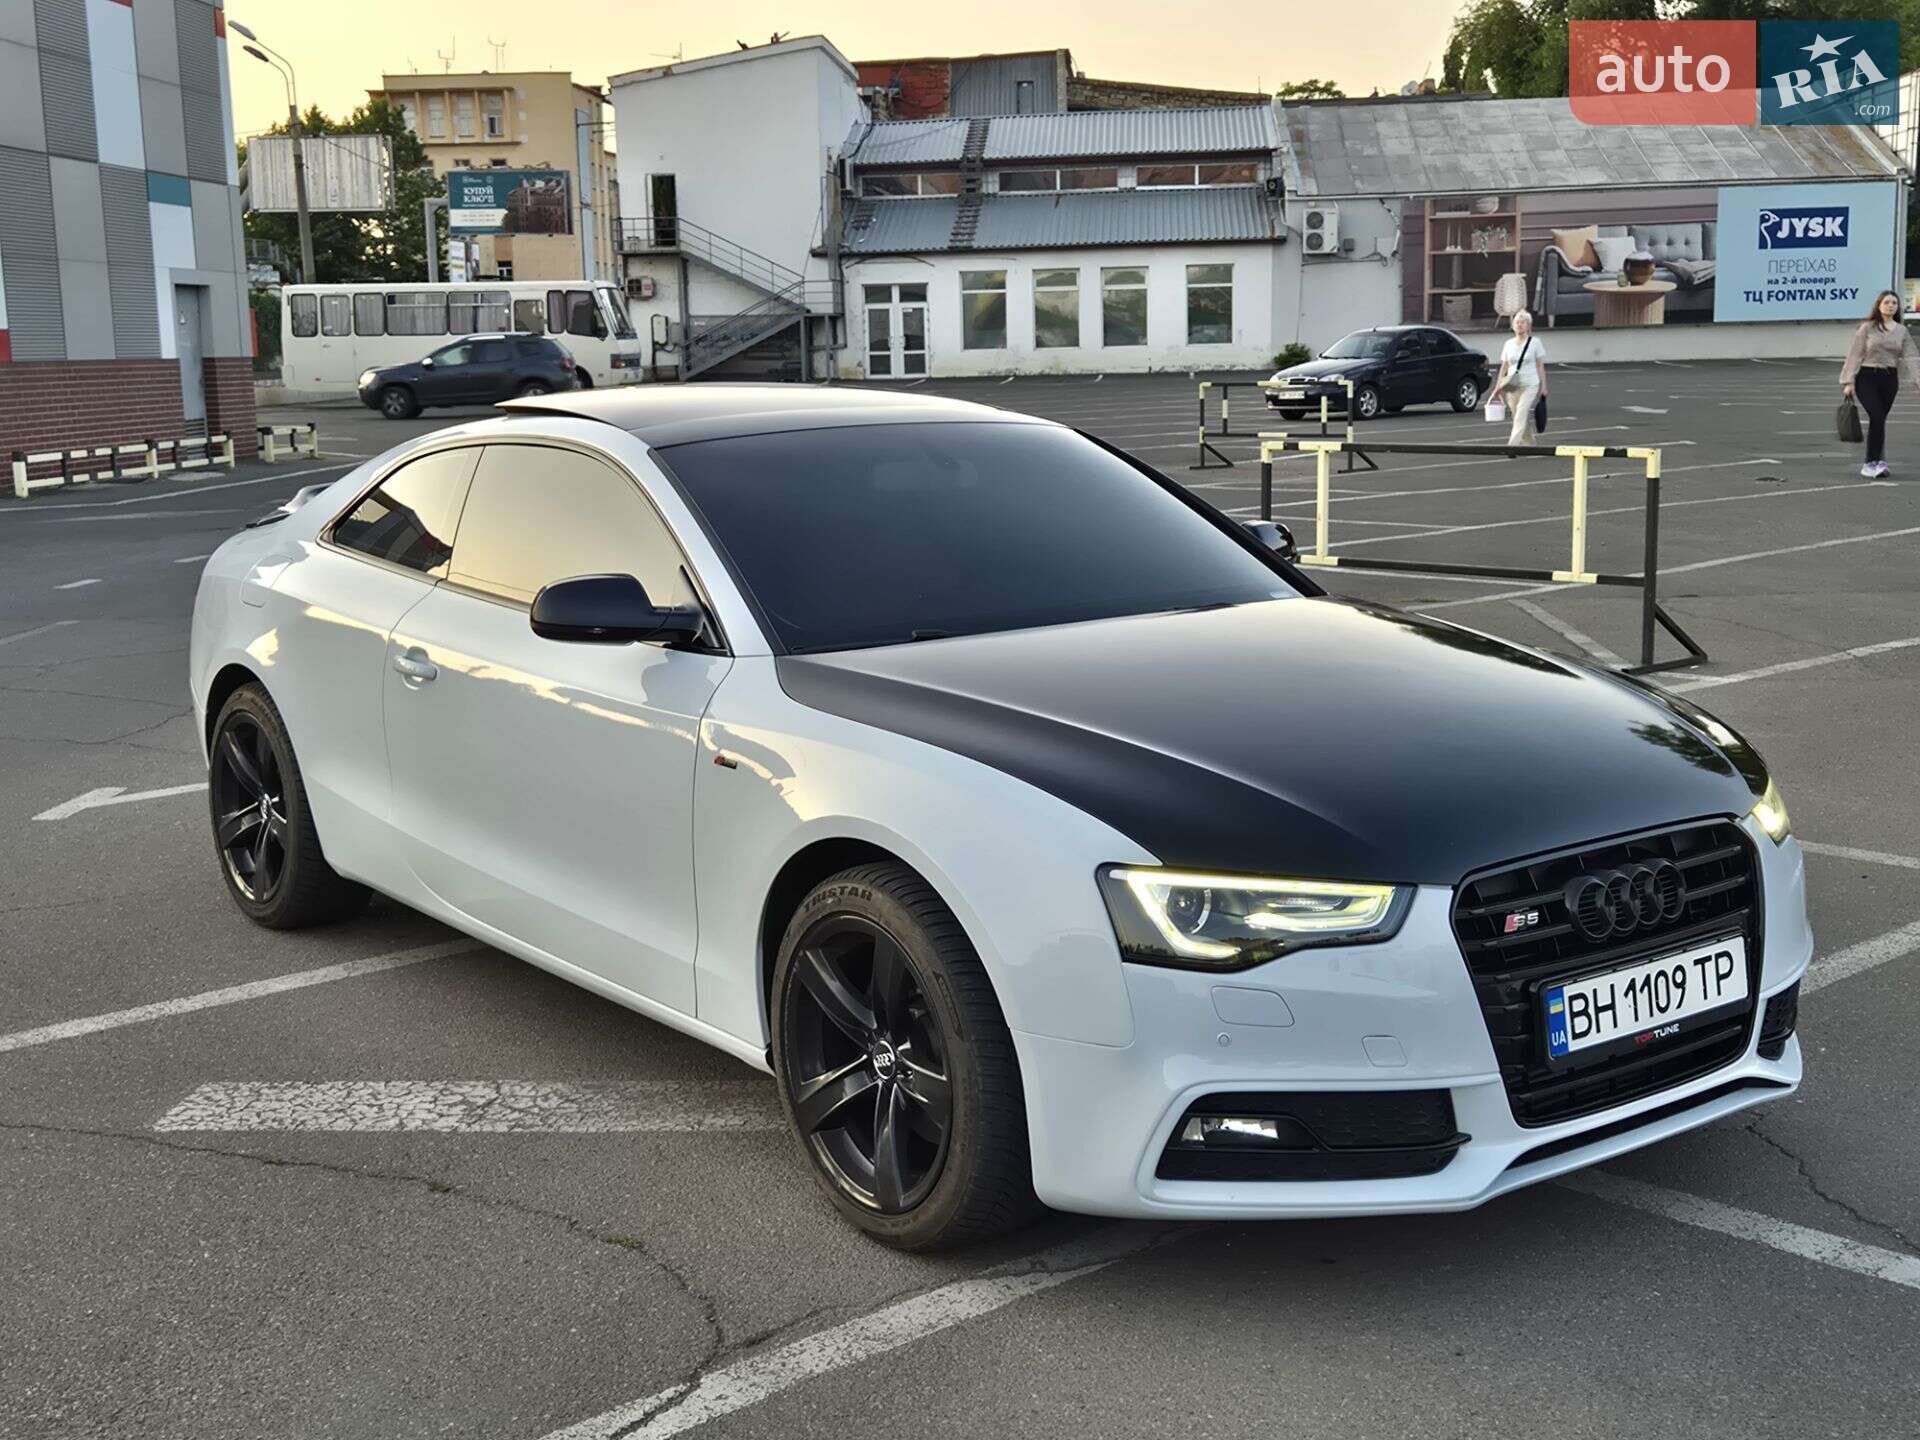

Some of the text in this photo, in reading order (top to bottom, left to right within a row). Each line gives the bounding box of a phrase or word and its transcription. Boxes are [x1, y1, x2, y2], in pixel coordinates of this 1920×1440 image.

[1776, 216, 1845, 239] JYSK
[1768, 257, 1838, 274] ПЕРЕЇХАВ
[1767, 276, 1837, 286] на 2-й поверх
[1743, 288, 1859, 304] ТЦ FONTAN SKY
[1512, 911, 1539, 927] S5
[1568, 950, 1734, 1041] BH 1109 TP
[1551, 1030, 1567, 1047] UA
